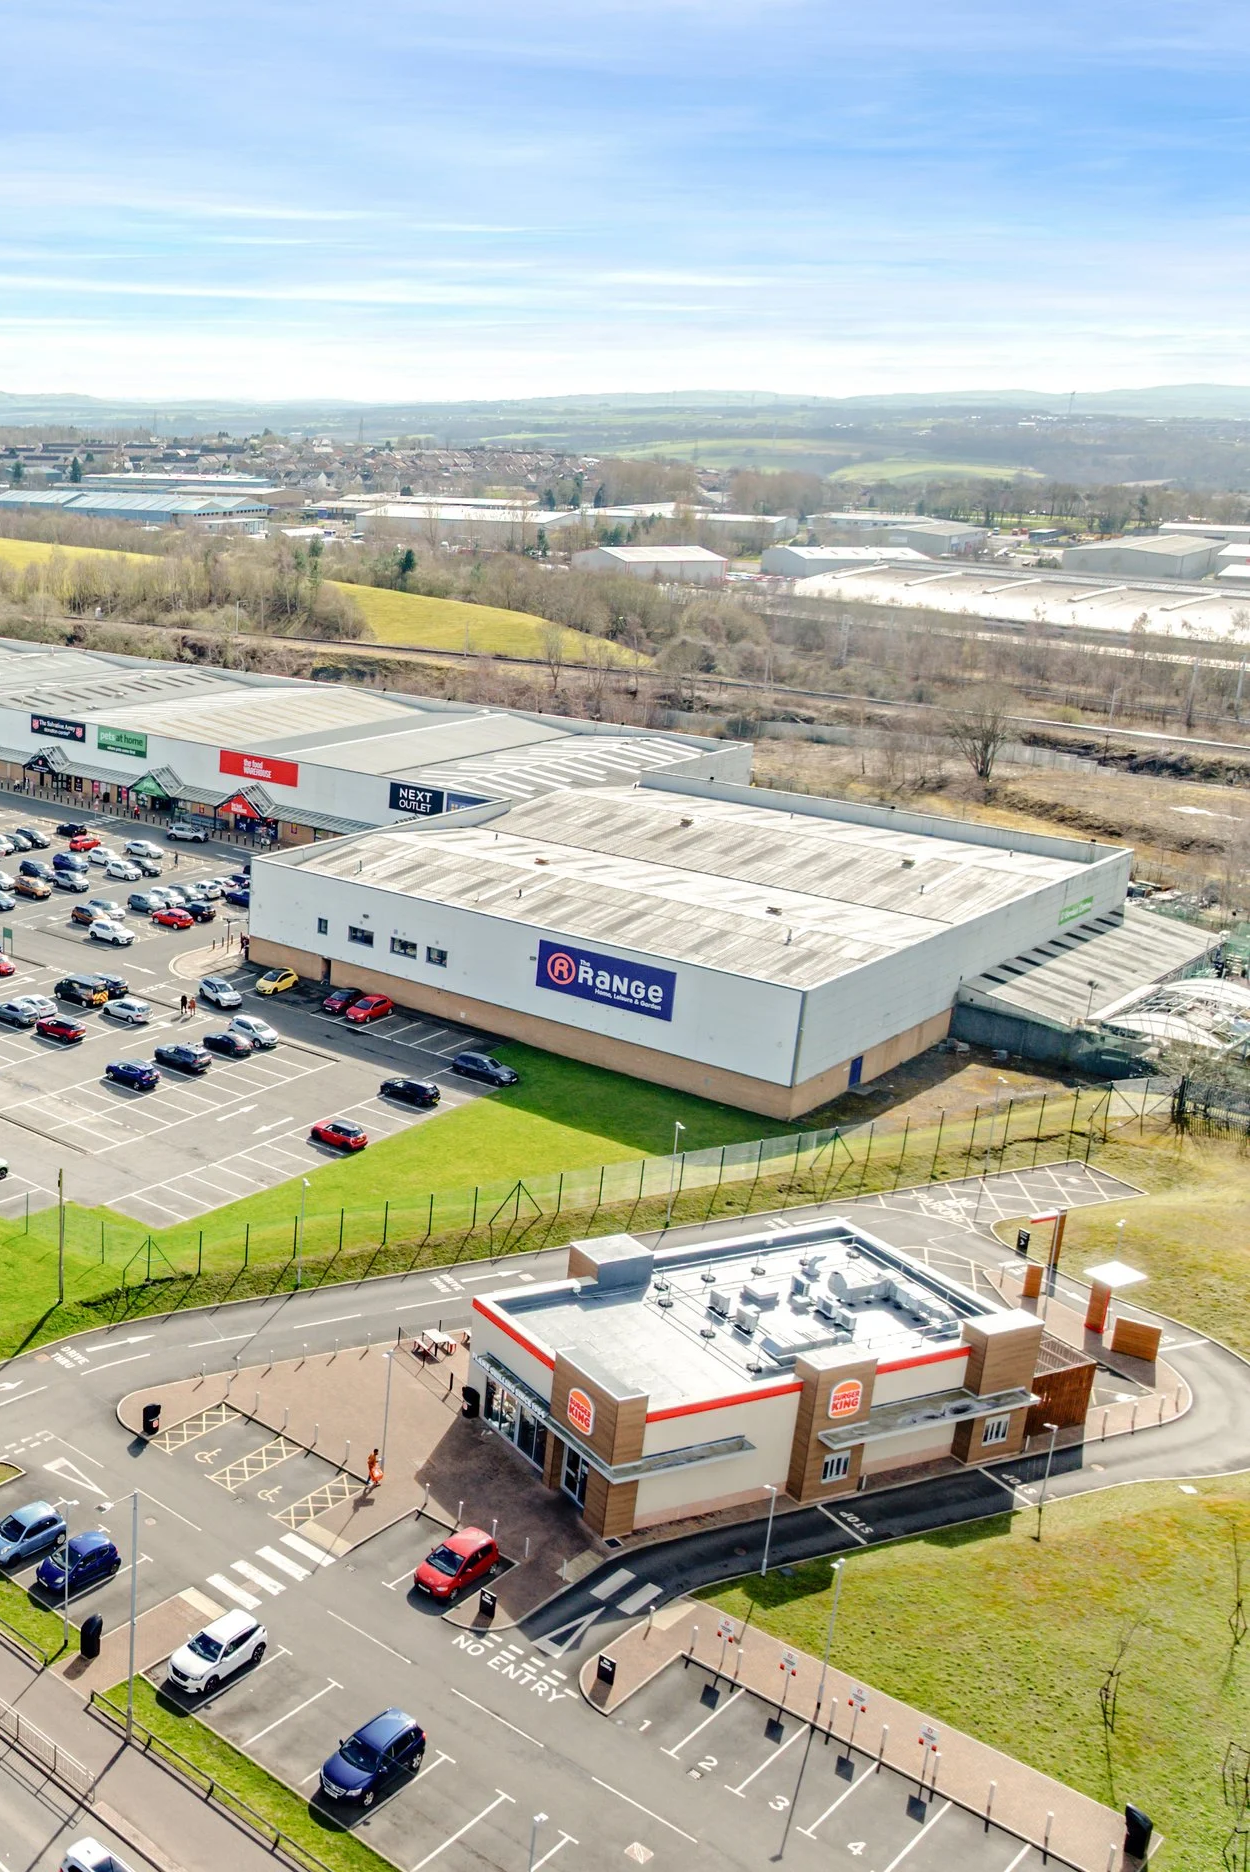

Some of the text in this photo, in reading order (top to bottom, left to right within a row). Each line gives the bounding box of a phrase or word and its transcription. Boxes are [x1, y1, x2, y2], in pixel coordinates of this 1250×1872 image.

[100, 731, 143, 746] pets at home
[243, 758, 263, 769] the food
[399, 787, 433, 803] NEXT
[399, 799, 432, 813] OUTLET
[580, 959, 590, 967] The
[594, 988, 612, 999] Home,
[613, 993, 633, 1004] Leisure
[640, 1000, 662, 1011] Garden
[51, 1352, 76, 1369] THRU
[61, 1345, 90, 1366] DRIVE
[833, 1390, 860, 1401] BURGER
[570, 1396, 591, 1418] BURGER
[832, 1397, 859, 1412] KING
[569, 1404, 591, 1428] KING
[1001, 1473, 1038, 1495] STOP
[839, 1511, 874, 1534] STOP
[451, 1634, 566, 1702] NO ENTRY
[638, 1719, 652, 1731] 1
[697, 1755, 718, 1772] 2
[768, 1795, 790, 1811] 3
[847, 1841, 867, 1855] 4
